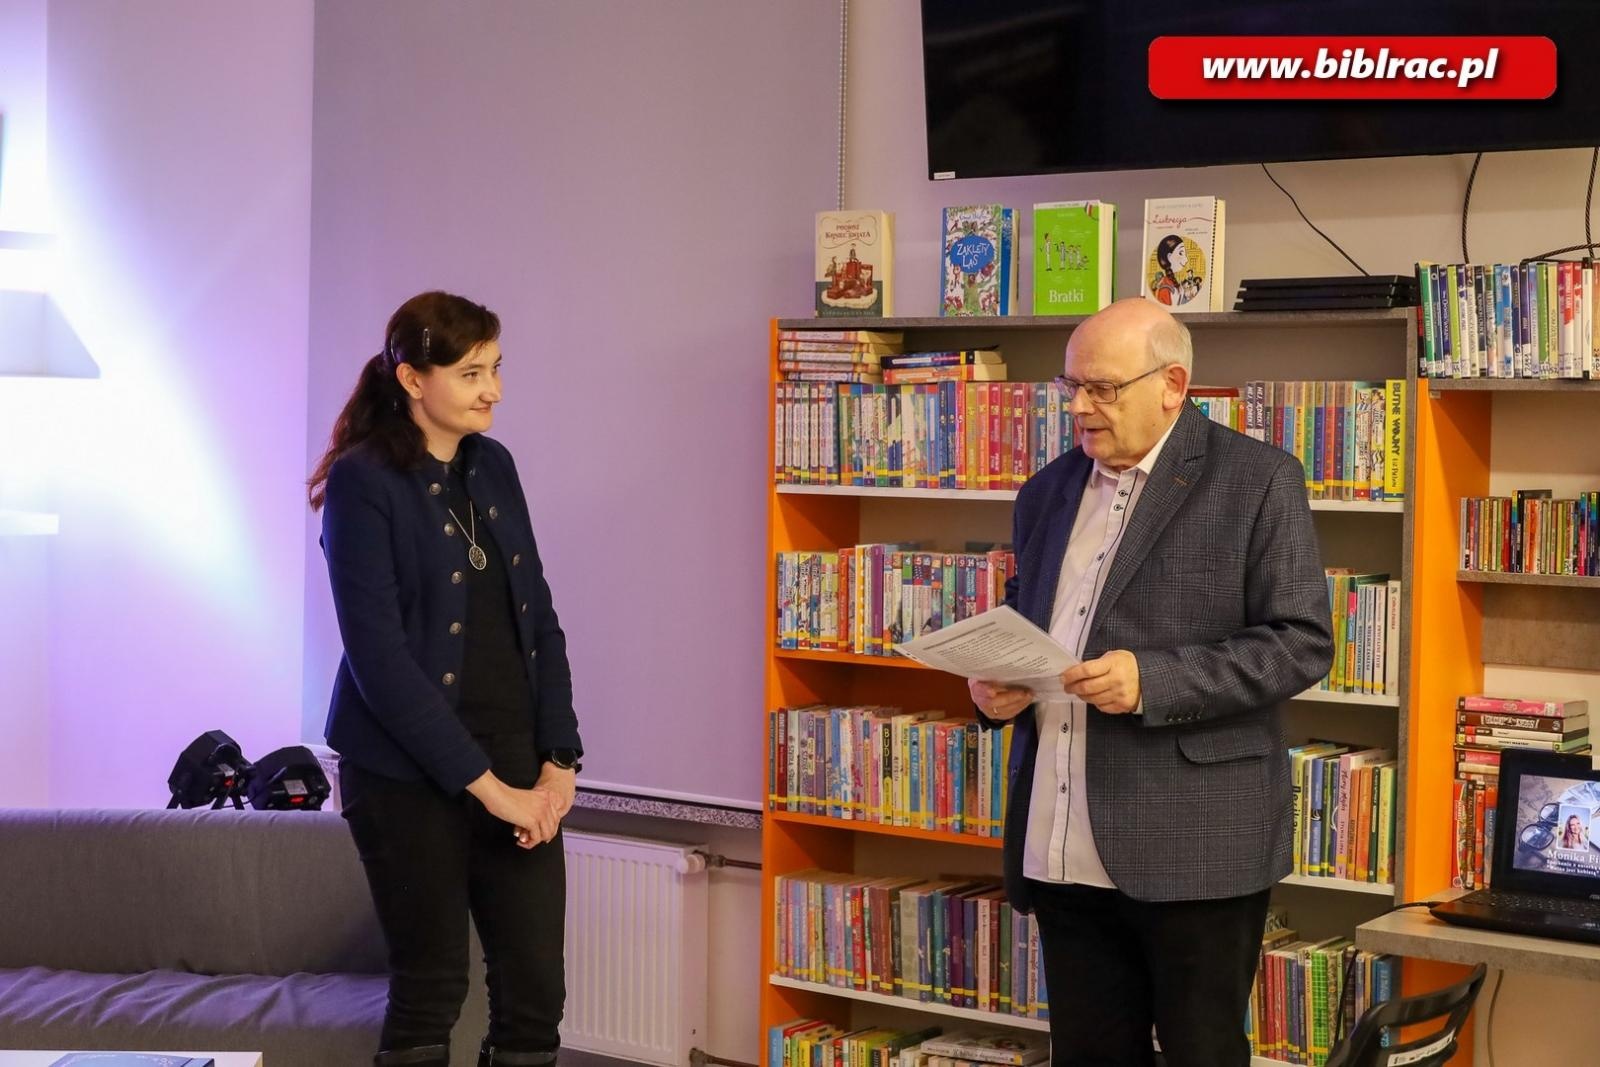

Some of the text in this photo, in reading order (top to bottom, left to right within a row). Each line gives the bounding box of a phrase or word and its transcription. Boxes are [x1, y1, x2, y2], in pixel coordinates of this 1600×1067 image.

[962, 254, 979, 269] LAS
[1049, 289, 1084, 303] Bratki
[1392, 382, 1401, 415] BUTNE
[1391, 418, 1401, 456] WOJNY
[1547, 849, 1585, 863] Monika
